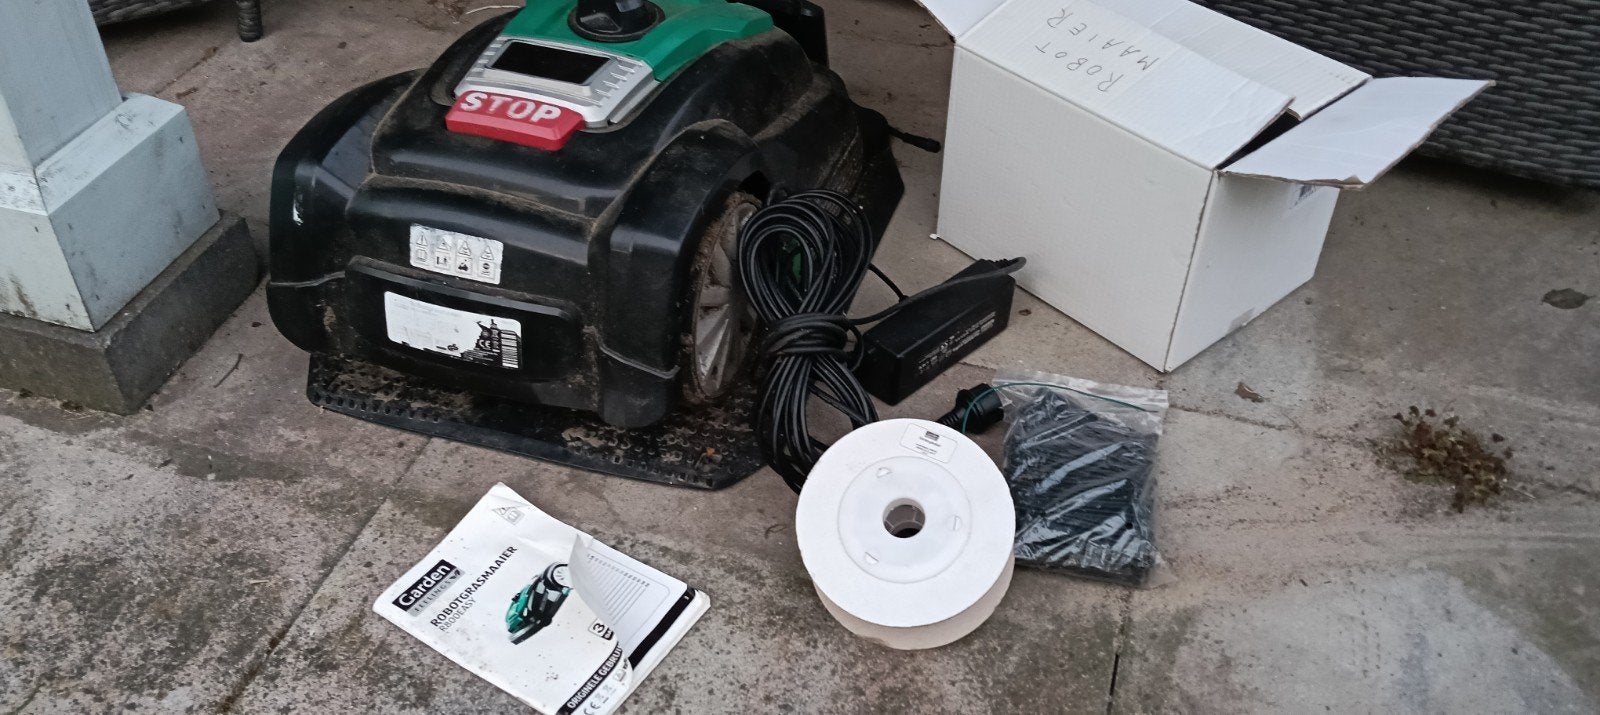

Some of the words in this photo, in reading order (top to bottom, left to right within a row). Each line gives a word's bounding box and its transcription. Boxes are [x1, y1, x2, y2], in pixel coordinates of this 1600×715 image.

[1046, 8, 1159, 70] MAAIER
[1035, 42, 1124, 92] ROBOT
[461, 92, 562, 123] STOP
[398, 565, 451, 606] Garden
[430, 546, 517, 627] ROBOTGRASMAAIER
[439, 597, 476, 632] R800EASY
[592, 622, 605, 633] 3
[566, 674, 602, 709] ORIGINELE
